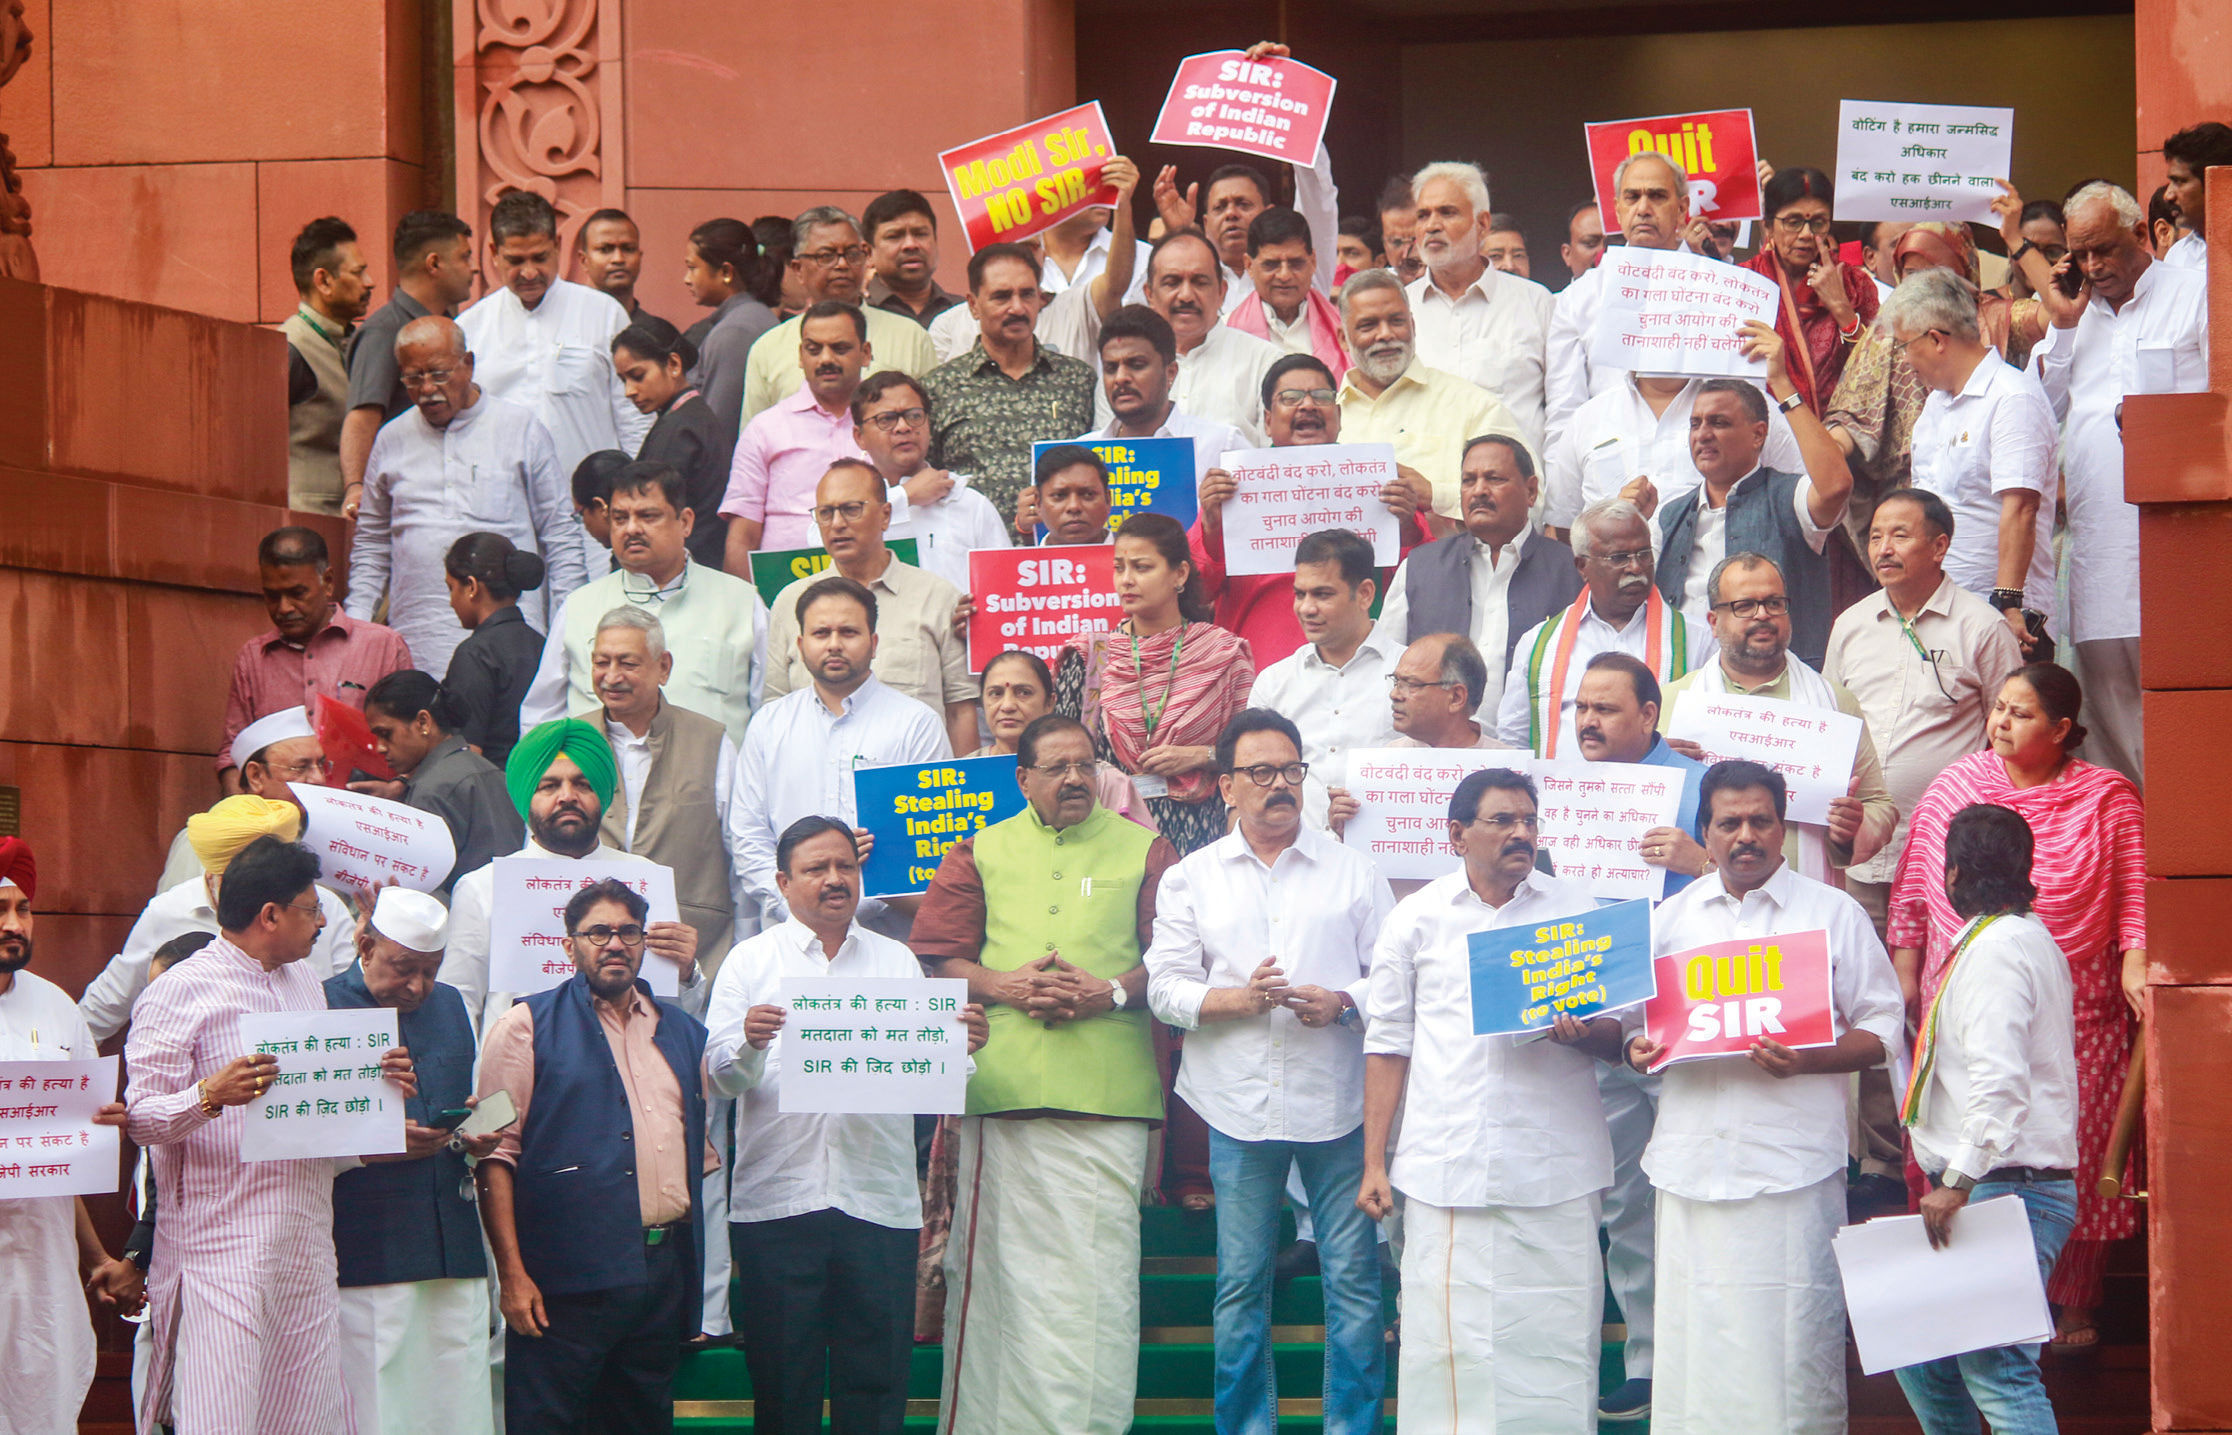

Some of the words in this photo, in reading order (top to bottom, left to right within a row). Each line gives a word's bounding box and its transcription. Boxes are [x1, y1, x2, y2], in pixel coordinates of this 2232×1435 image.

[1218, 60, 1284, 88] SIR:
[1184, 84, 1309, 115] Subversion
[1191, 102, 1217, 118] of
[1219, 104, 1291, 131] Indian
[1852, 117, 1887, 132] वोटिंग
[1893, 119, 1902, 133] है
[1908, 122, 1941, 134] हमारा
[1187, 121, 1286, 149] Republic
[1901, 144, 1948, 159] अधिकार
[953, 140, 1043, 199] Modi
[1045, 127, 1105, 167] Sir,
[1851, 167, 1868, 182] बंद
[1875, 170, 1895, 183] करो
[1902, 174, 1921, 185] हक
[1928, 172, 1962, 186] छीनने
[1968, 176, 1994, 188] वाला
[984, 187, 1032, 233] NO
[1035, 167, 1095, 215] SIR.
[1891, 196, 1952, 210] एसआईआर
[1621, 287, 1640, 300] का
[1643, 290, 1667, 302] गला
[1735, 299, 1760, 315] करो
[1639, 313, 1672, 329] चुनाव
[1675, 312, 1715, 327] आयोग
[1719, 313, 1738, 328] की
[1622, 333, 1681, 350] तानाशाही
[1684, 336, 1708, 350] नहीं
[1092, 446, 1136, 463] SIR:
[1339, 458, 1387, 476] लोकतंत्र
[1108, 466, 1160, 489] aling
[1240, 492, 1258, 504] का
[1262, 490, 1287, 503] गला
[1262, 514, 1297, 531] चुनाव
[1301, 508, 1342, 525] आयोग
[1345, 506, 1363, 522] की
[1017, 559, 1086, 587] SIR:
[986, 588, 1120, 612] Subversion
[1001, 616, 1027, 637] of
[1033, 614, 1108, 635] Indian
[1707, 705, 1753, 720] लोकतंत्र
[1759, 710, 1776, 723] की
[1782, 716, 1812, 729] हत्या
[1818, 720, 1828, 733] है
[1729, 730, 1797, 750] एसआईआर
[918, 768, 966, 789] SIR:
[1812, 765, 1822, 779] है
[1366, 790, 1384, 804] का
[1388, 791, 1415, 804] गला
[1420, 787, 1455, 804] घोंट
[1544, 776, 1573, 791] जिसने
[1578, 779, 1606, 798] तुमको
[1610, 782, 1636, 795] सत्ता
[894, 788, 994, 814] Stealing
[1386, 816, 1422, 833] चुनाव
[1544, 808, 1558, 821] वह
[1563, 805, 1570, 821] है
[1576, 809, 1599, 826] चुनने
[1603, 810, 1614, 821] का
[1619, 808, 1658, 825] अधिकार
[915, 835, 963, 860] Rig
[1371, 837, 1435, 855] तानाशाही
[1537, 835, 1558, 848] आज
[1563, 834, 1580, 850] वही
[1585, 835, 1623, 851] अधिकार
[329, 838, 370, 862] संविधान
[374, 854, 388, 867] पर
[392, 858, 418, 876] संकट
[420, 865, 429, 882] है
[1563, 865, 1586, 878] करते
[1592, 864, 1601, 879] हो
[526, 875, 573, 891] लोकतंत्र
[640, 878, 648, 894] है
[521, 932, 565, 947] संविधा
[1535, 923, 1584, 943] SIR:
[1510, 935, 1612, 967] Stealing
[542, 960, 575, 975] बीजेप
[1522, 954, 1603, 985] India's
[1686, 945, 1783, 1001] Quit
[1531, 971, 1596, 1002] Right
[792, 994, 842, 1010] लोकतंत्र
[850, 995, 868, 1010] की
[875, 998, 907, 1012] हत्या
[928, 997, 957, 1012] SIR
[1522, 1005, 1549, 1025] (to
[1553, 985, 1606, 1012] vote)
[1686, 997, 1787, 1042] SIR
[255, 1036, 298, 1054] लोकतंत्र
[304, 1035, 319, 1051] की
[325, 1037, 351, 1052] हत्या
[368, 1032, 390, 1048] SIR
[801, 1029, 853, 1042] मतदाता
[861, 1026, 878, 1042] को
[886, 1029, 909, 1042] मत
[803, 1059, 832, 1074] SIR
[841, 1057, 859, 1073] की
[19, 1076, 36, 1090] की
[43, 1078, 74, 1091] हत्या
[80, 1075, 90, 1091] है
[274, 1072, 307, 1086] तदाता
[313, 1067, 327, 1082] को
[333, 1069, 352, 1080] मत
[0, 1103, 58, 1119] सआईआर
[265, 1104, 289, 1119] SIR
[296, 1100, 311, 1116] की
[16, 1137, 32, 1148] पर
[40, 1131, 73, 1147] संकट
[80, 1130, 90, 1146] है
[29, 1163, 71, 1177] सरकार
